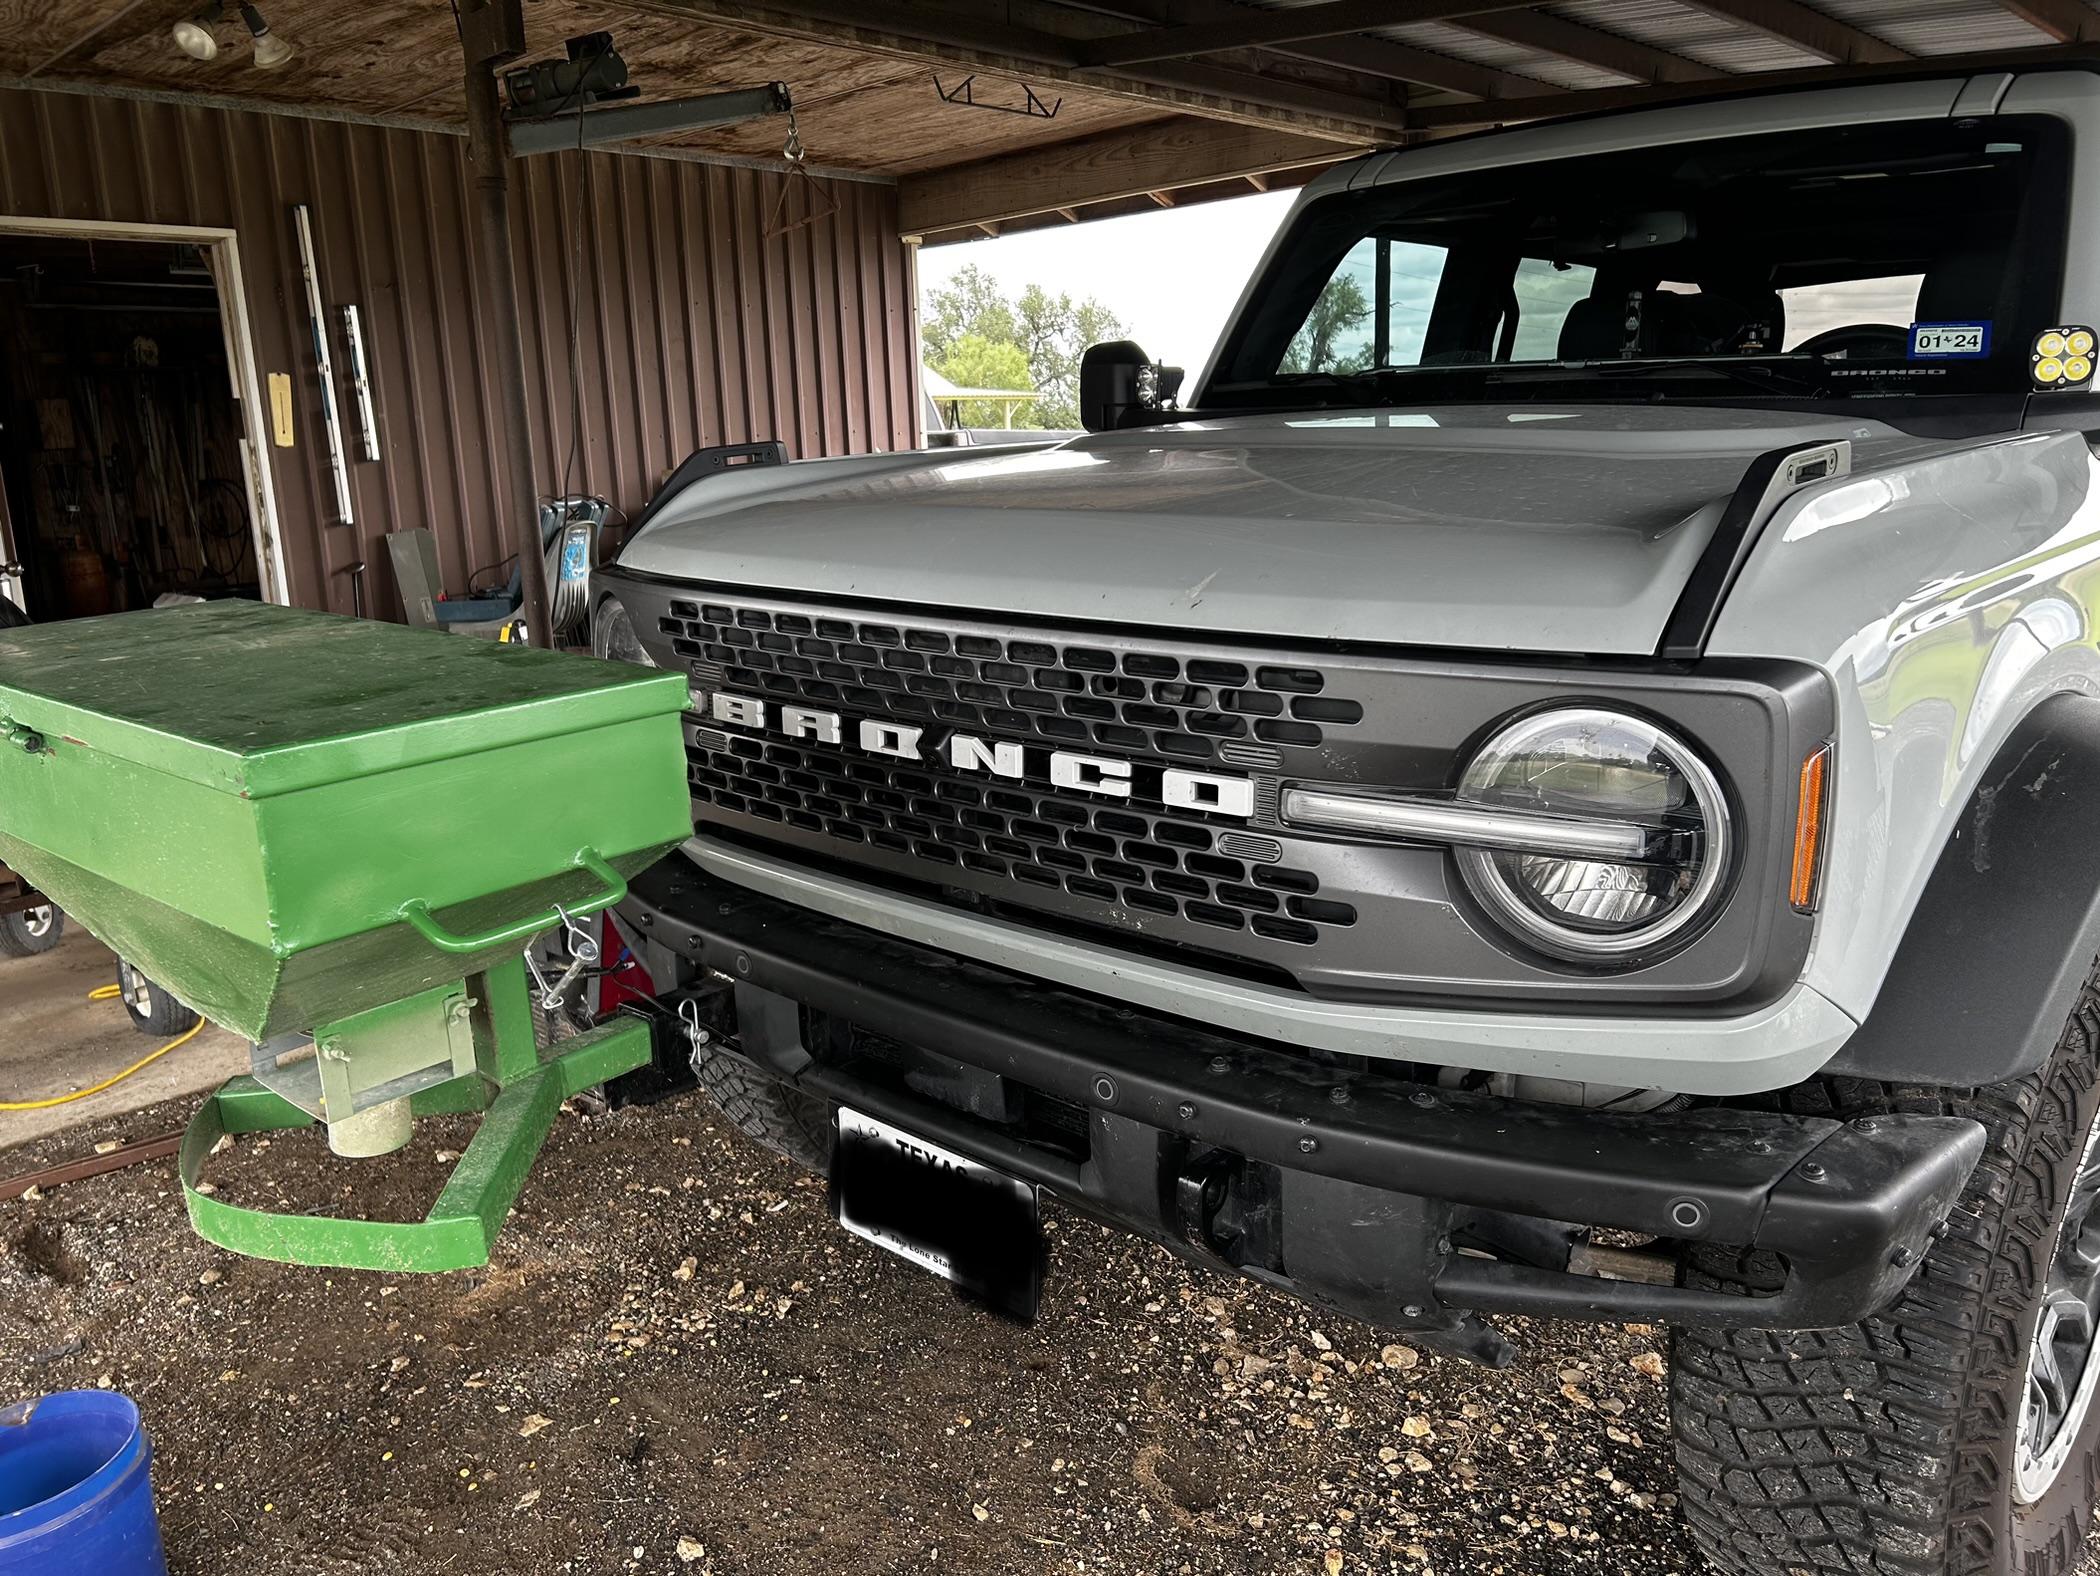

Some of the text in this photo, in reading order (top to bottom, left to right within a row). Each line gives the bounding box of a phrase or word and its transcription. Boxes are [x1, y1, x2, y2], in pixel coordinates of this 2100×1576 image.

[1919, 334, 1978, 348] 01 24
[712, 692, 1254, 817] BRONCO
[890, 1233, 952, 1269] The Lone Star
